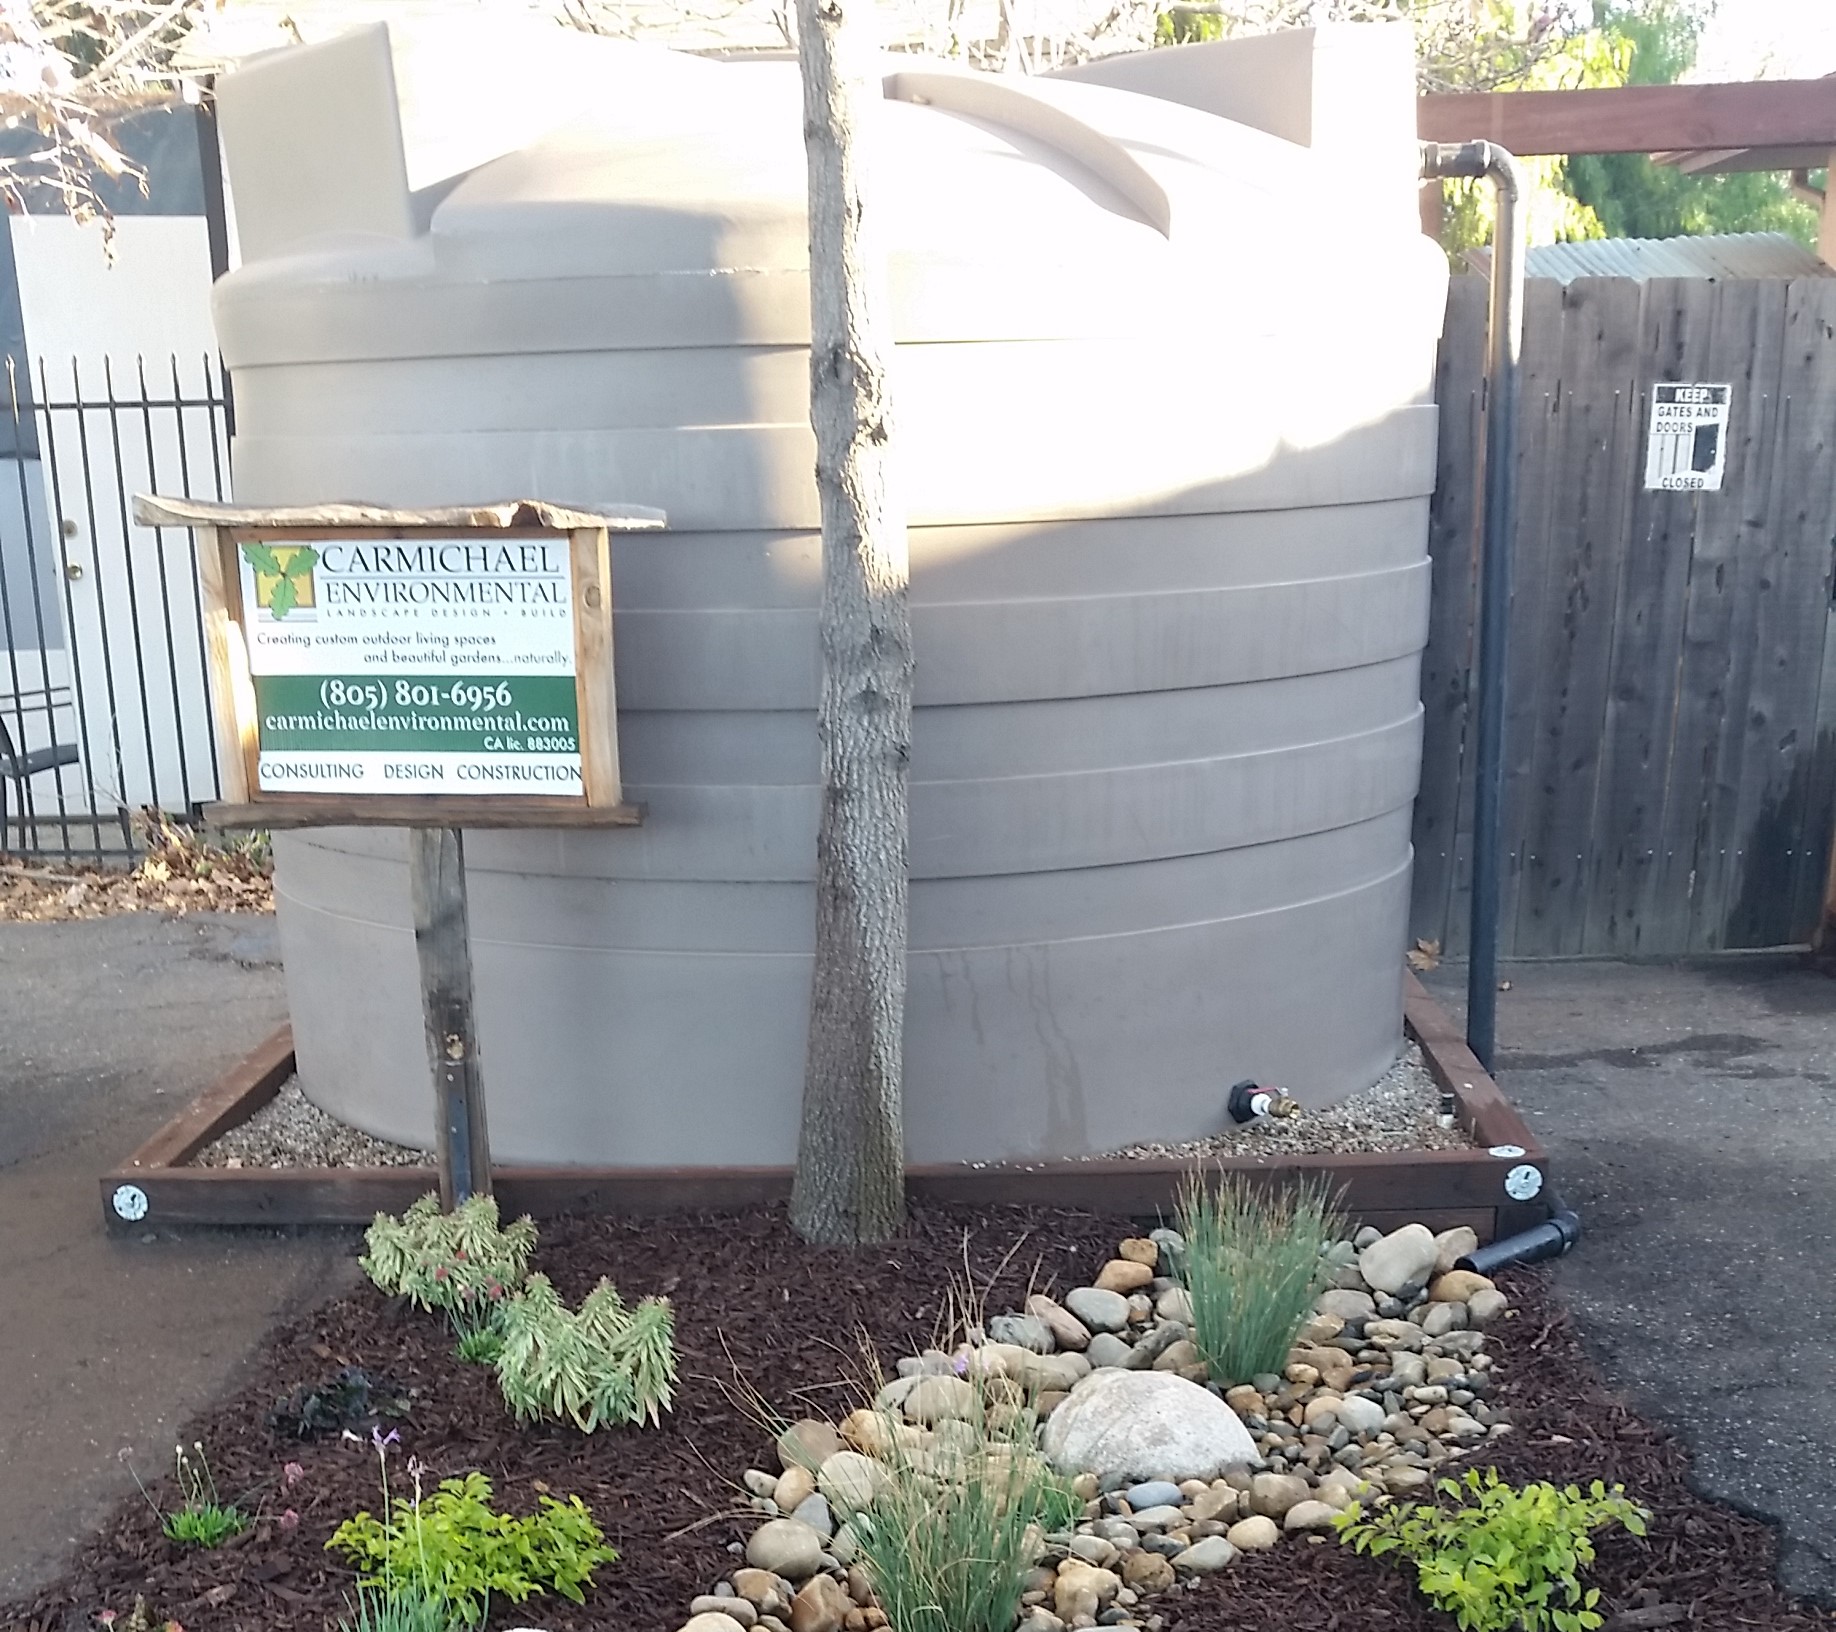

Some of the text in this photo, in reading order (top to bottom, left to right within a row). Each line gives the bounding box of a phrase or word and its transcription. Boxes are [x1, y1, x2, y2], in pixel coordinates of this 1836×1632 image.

[1675, 388, 1708, 403] KEEP
[1658, 406, 1719, 418] GATES AND
[1656, 421, 1693, 433] DOORS
[1662, 477, 1705, 489] CLOSED
[322, 545, 559, 573] CARMICHAEL
[326, 582, 567, 604] ENVIRONMENTAL
[327, 608, 567, 618] LANDSCAPE DESIGN BUILD
[257, 631, 496, 648] Creating custom outdoor living spaces
[364, 650, 388, 663] and
[392, 649, 446, 663] beautiful
[320, 679, 512, 712] (805) 801-6956
[265, 710, 570, 732] carmichaelenvironmental.com
[483, 735, 576, 751] CA lic. 883005
[260, 763, 582, 782] CONSULTING DESIGN CONSTRUCTION
